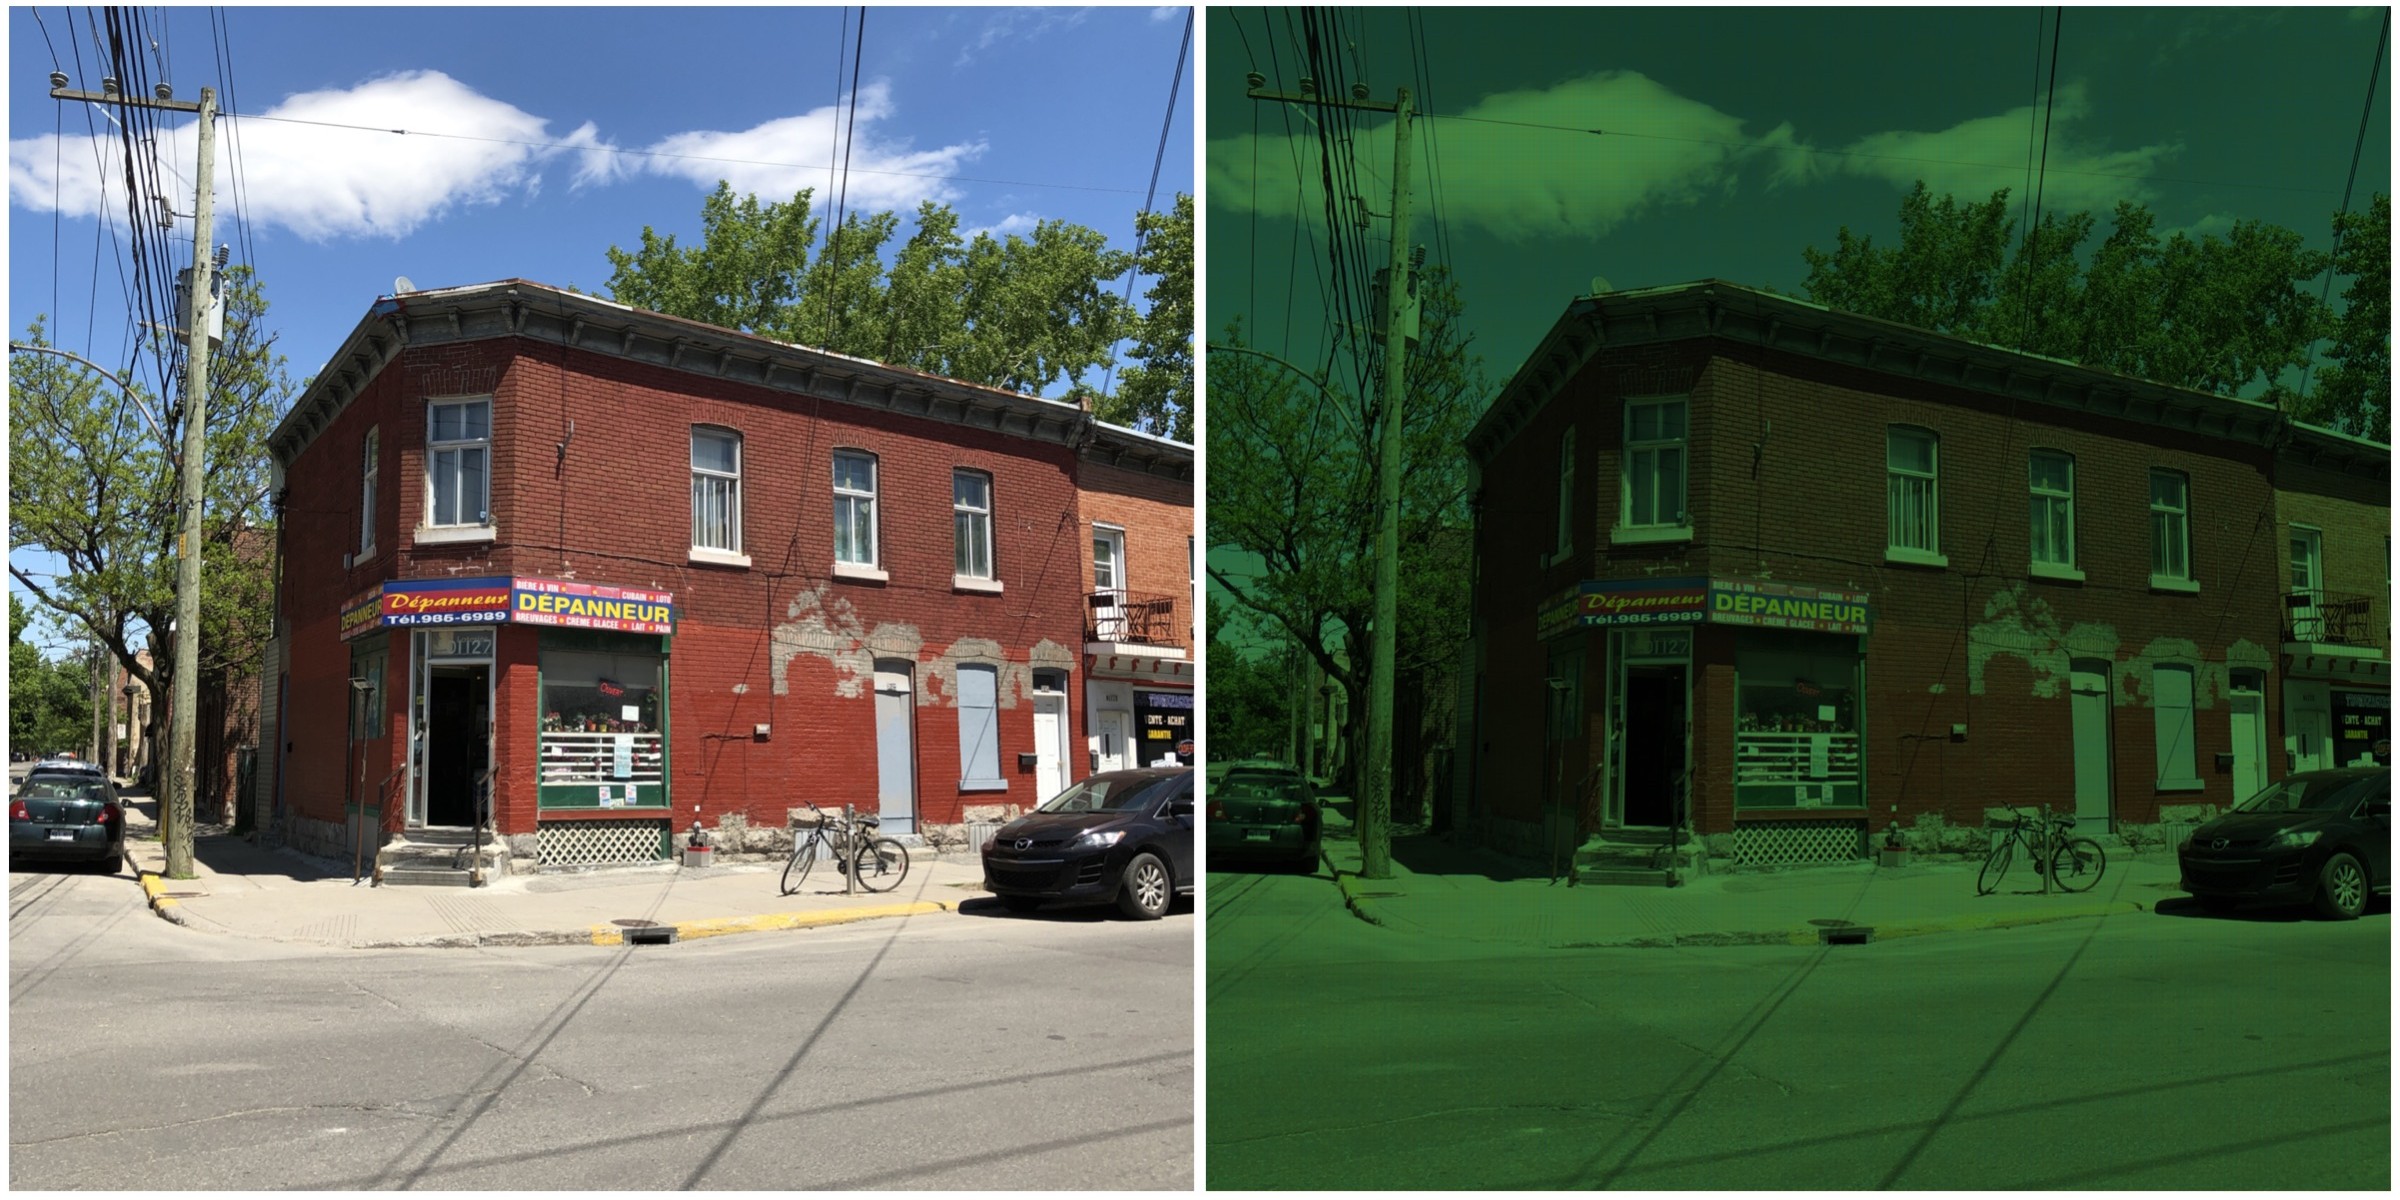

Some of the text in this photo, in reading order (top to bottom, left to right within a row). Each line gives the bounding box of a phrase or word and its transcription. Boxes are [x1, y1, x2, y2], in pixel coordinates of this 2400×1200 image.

[539, 582, 545, 592] &
[546, 583, 559, 593] VIN
[622, 591, 647, 602] CUBAIN
[656, 594, 672, 604] LOTO
[1736, 582, 1742, 592] &
[386, 593, 508, 613] Dépanneur
[519, 593, 670, 624] DÉPANNEUR
[1583, 593, 1705, 613] Dépanneur
[1716, 593, 1867, 624] DÉPANNEUR
[515, 612, 558, 625] BREUVAGES
[631, 622, 645, 632] LAIT
[655, 624, 671, 634] PAIN
[1712, 612, 1755, 625] BREUVAGES
[1828, 622, 1842, 632] LAIT
[1852, 624, 1868, 634] PAIN
